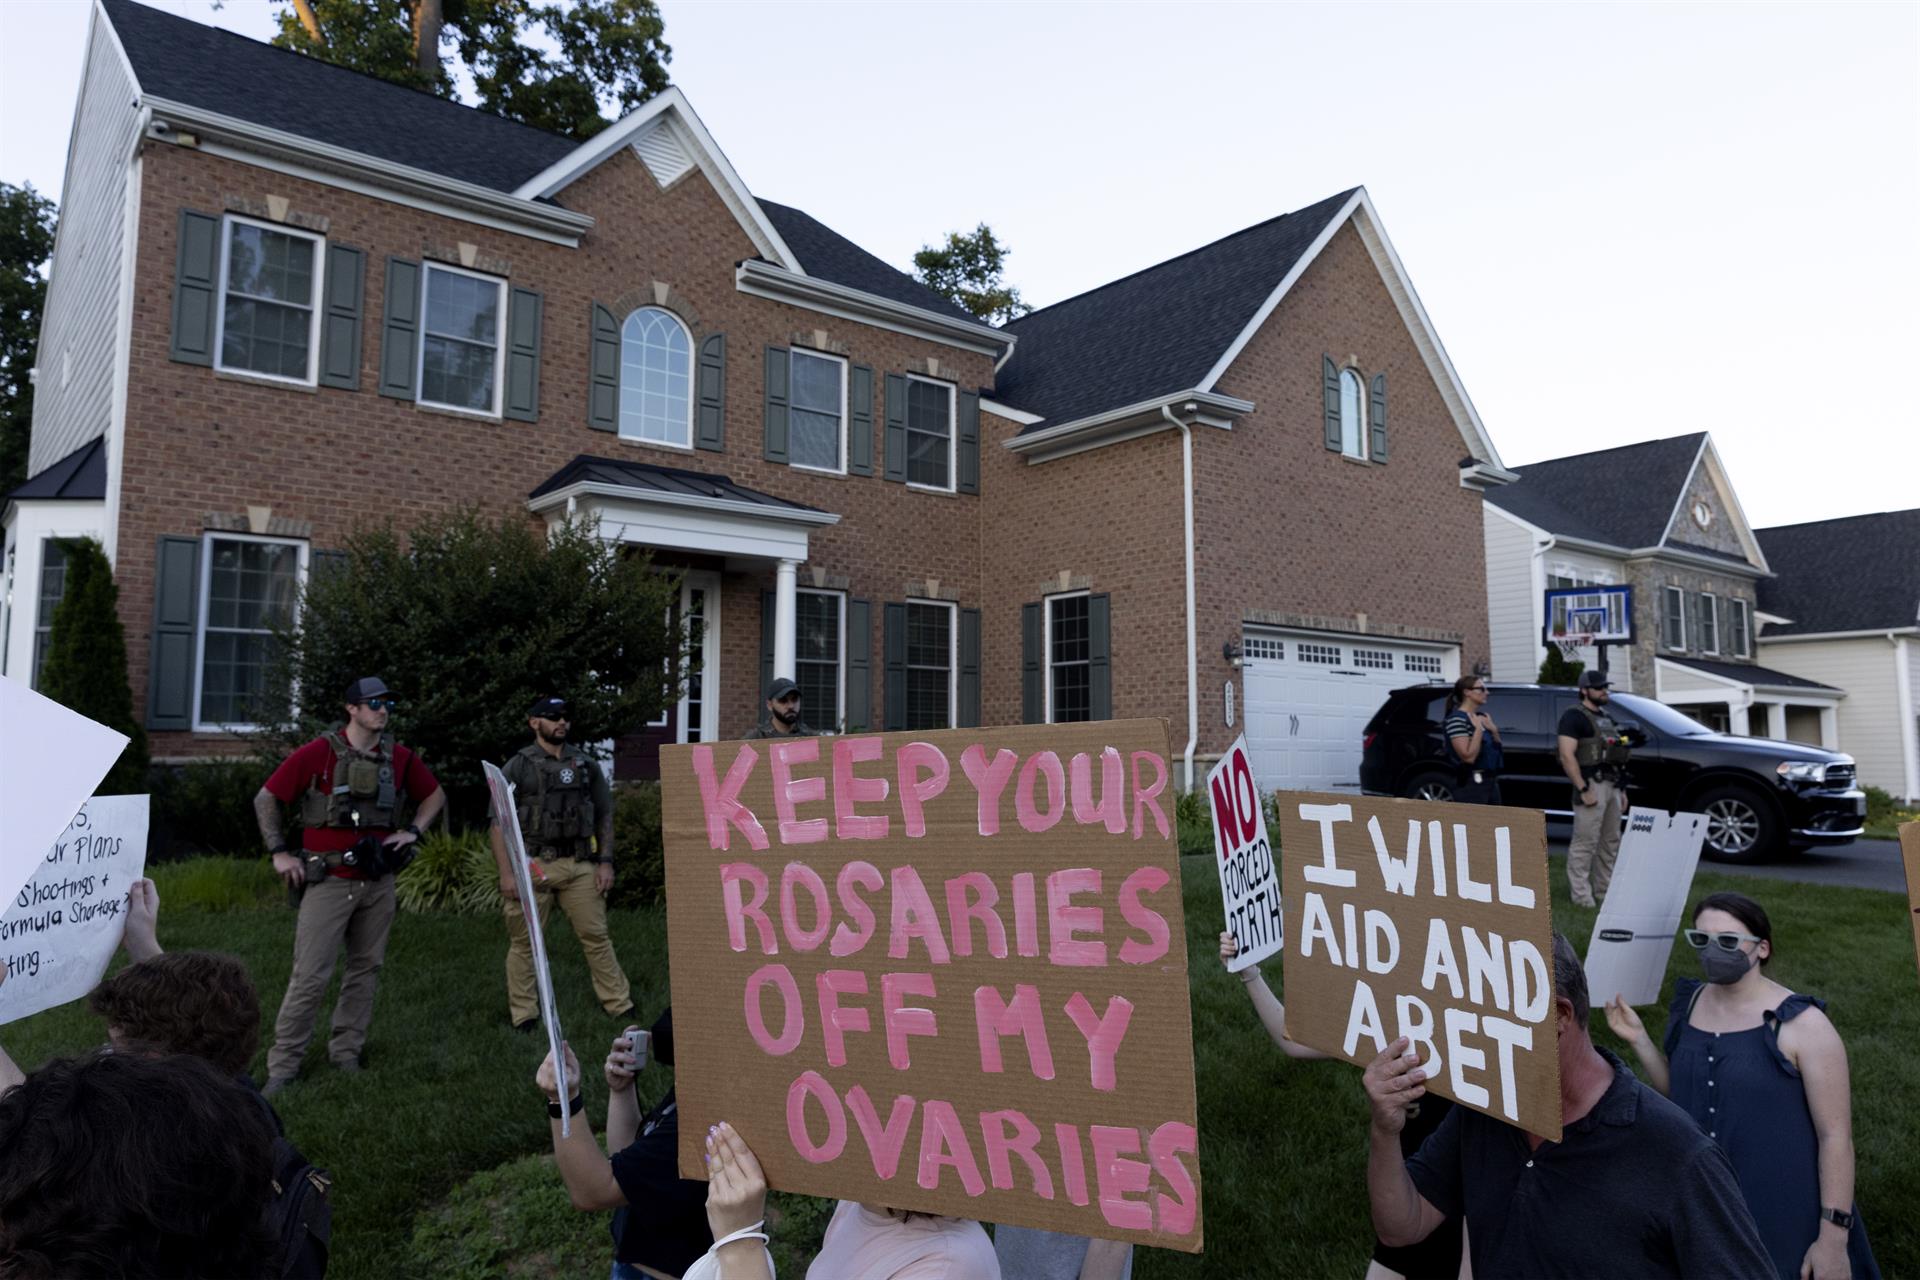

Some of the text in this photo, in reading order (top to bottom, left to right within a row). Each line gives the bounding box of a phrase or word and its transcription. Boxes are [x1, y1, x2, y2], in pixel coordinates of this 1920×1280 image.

[692, 737, 1170, 850] KEEP YOUR
[1211, 748, 1257, 861] NO
[17, 874, 95, 908] Shootings
[46, 833, 123, 865] ur Plans
[1224, 838, 1271, 904] FORCED
[1299, 803, 1536, 909] I WILL
[0, 910, 63, 940] ormula
[720, 860, 1170, 967] ROSARIES
[1230, 883, 1283, 960] BIRTH
[1300, 892, 1551, 1023] AID AND
[744, 964, 1134, 1091] OFF MY
[1343, 980, 1533, 1121] ABET
[786, 1070, 1197, 1236] OVARIES
